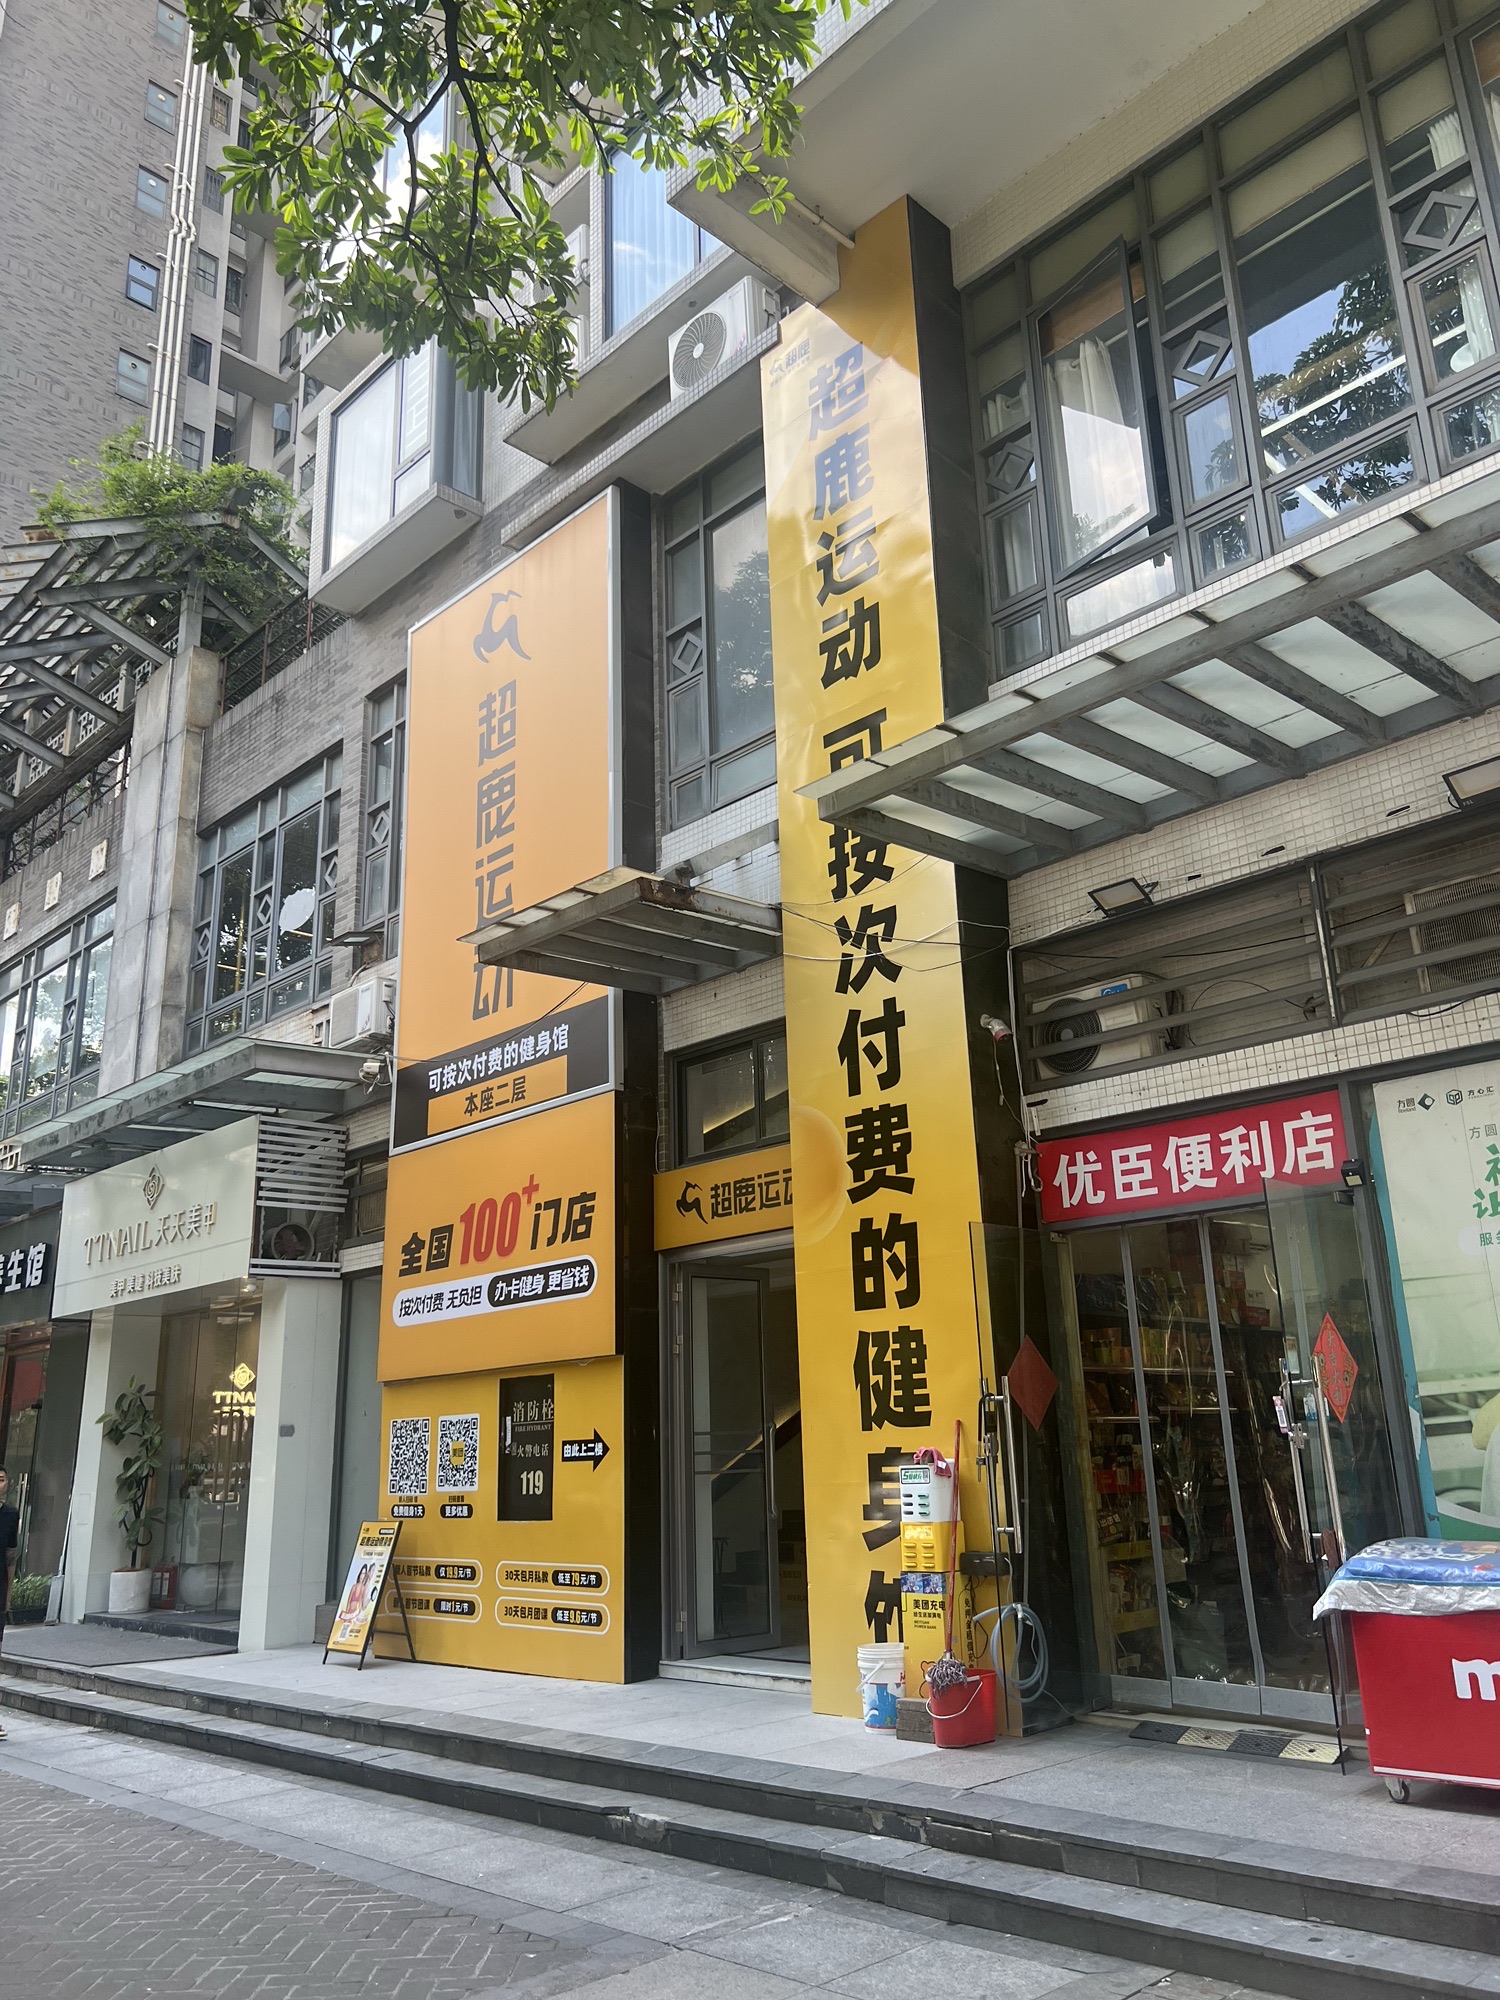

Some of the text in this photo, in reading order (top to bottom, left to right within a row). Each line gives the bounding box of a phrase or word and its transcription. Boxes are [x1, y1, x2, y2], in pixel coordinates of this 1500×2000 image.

[428, 1024, 569, 1093] 可按次付费的健身馆
[463, 1075, 527, 1117] 本座二层
[1052, 1110, 1335, 1209] 优臣便利店
[84, 1201, 218, 1266] TTNAIL 天天美甲
[0, 1242, 46, 1293] 生馆
[398, 1264, 591, 1319] 按次付费 无负担 办卡健身 更省钱
[513, 1398, 554, 1422] 消防栓
[526, 1423, 552, 1432] HYDRANT
[517, 1443, 549, 1458] 火警电话
[563, 1442, 604, 1458] 由此上二楼
[520, 1469, 544, 1495] 119
[444, 1505, 469, 1517] 更多优惠
[504, 1569, 597, 1587] 30天包月私教 低至79元/节
[504, 1606, 598, 1625] 30天包月团课 低至9.6元/节
[913, 1599, 947, 1611] 美团充电
